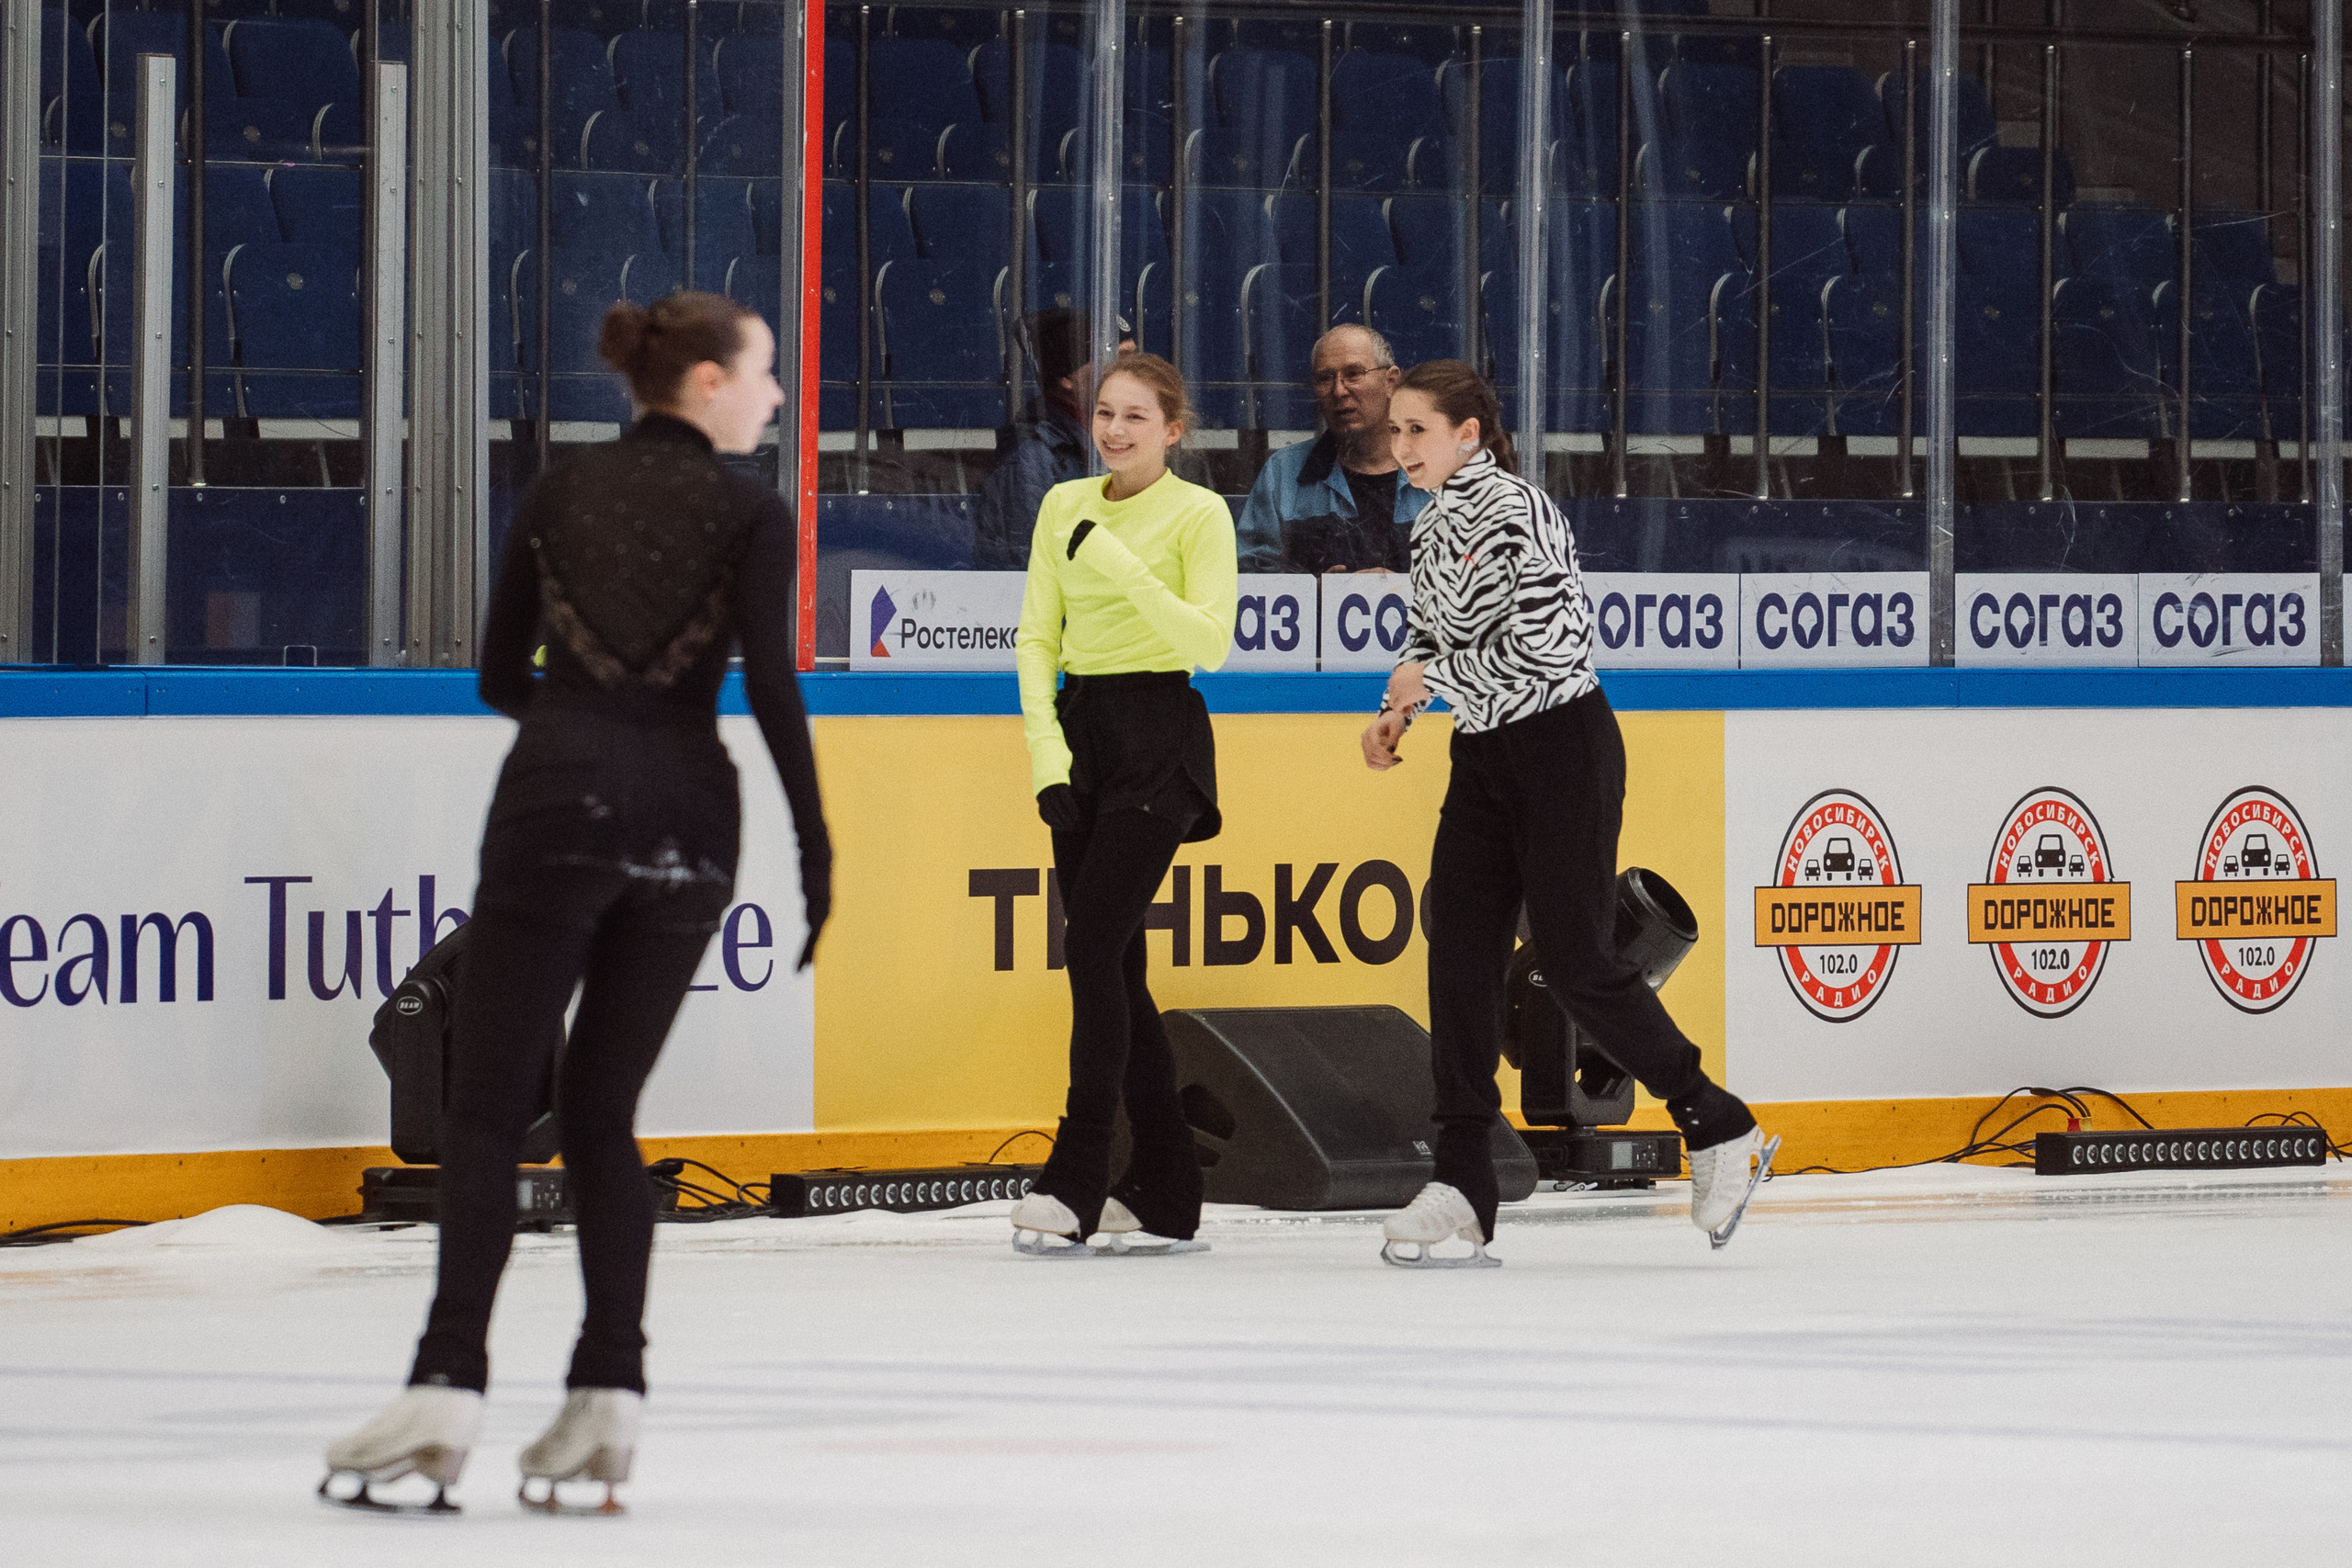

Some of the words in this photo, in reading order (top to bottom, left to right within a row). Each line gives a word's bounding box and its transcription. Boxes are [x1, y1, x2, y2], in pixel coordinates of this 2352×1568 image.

[901, 618, 1019, 649] Ростелек
[1584, 592, 1724, 649] огаз
[1788, 807, 1889, 873] НОВОСИБИРСК
[1999, 804, 2099, 869] НОВОСИБИРСК
[2207, 804, 2305, 868] НОВОСИБИРСК
[968, 859, 1432, 972] ТНЬКО
[0, 911, 214, 1008] eam
[1819, 953, 1858, 974] 102.0
[2031, 948, 2070, 970] 102.0
[2238, 946, 2275, 966] 102.0
[1802, 969, 1876, 1007] РАДИО
[2014, 965, 2087, 1003] РАДИО
[2222, 962, 2293, 998] РАДИО
